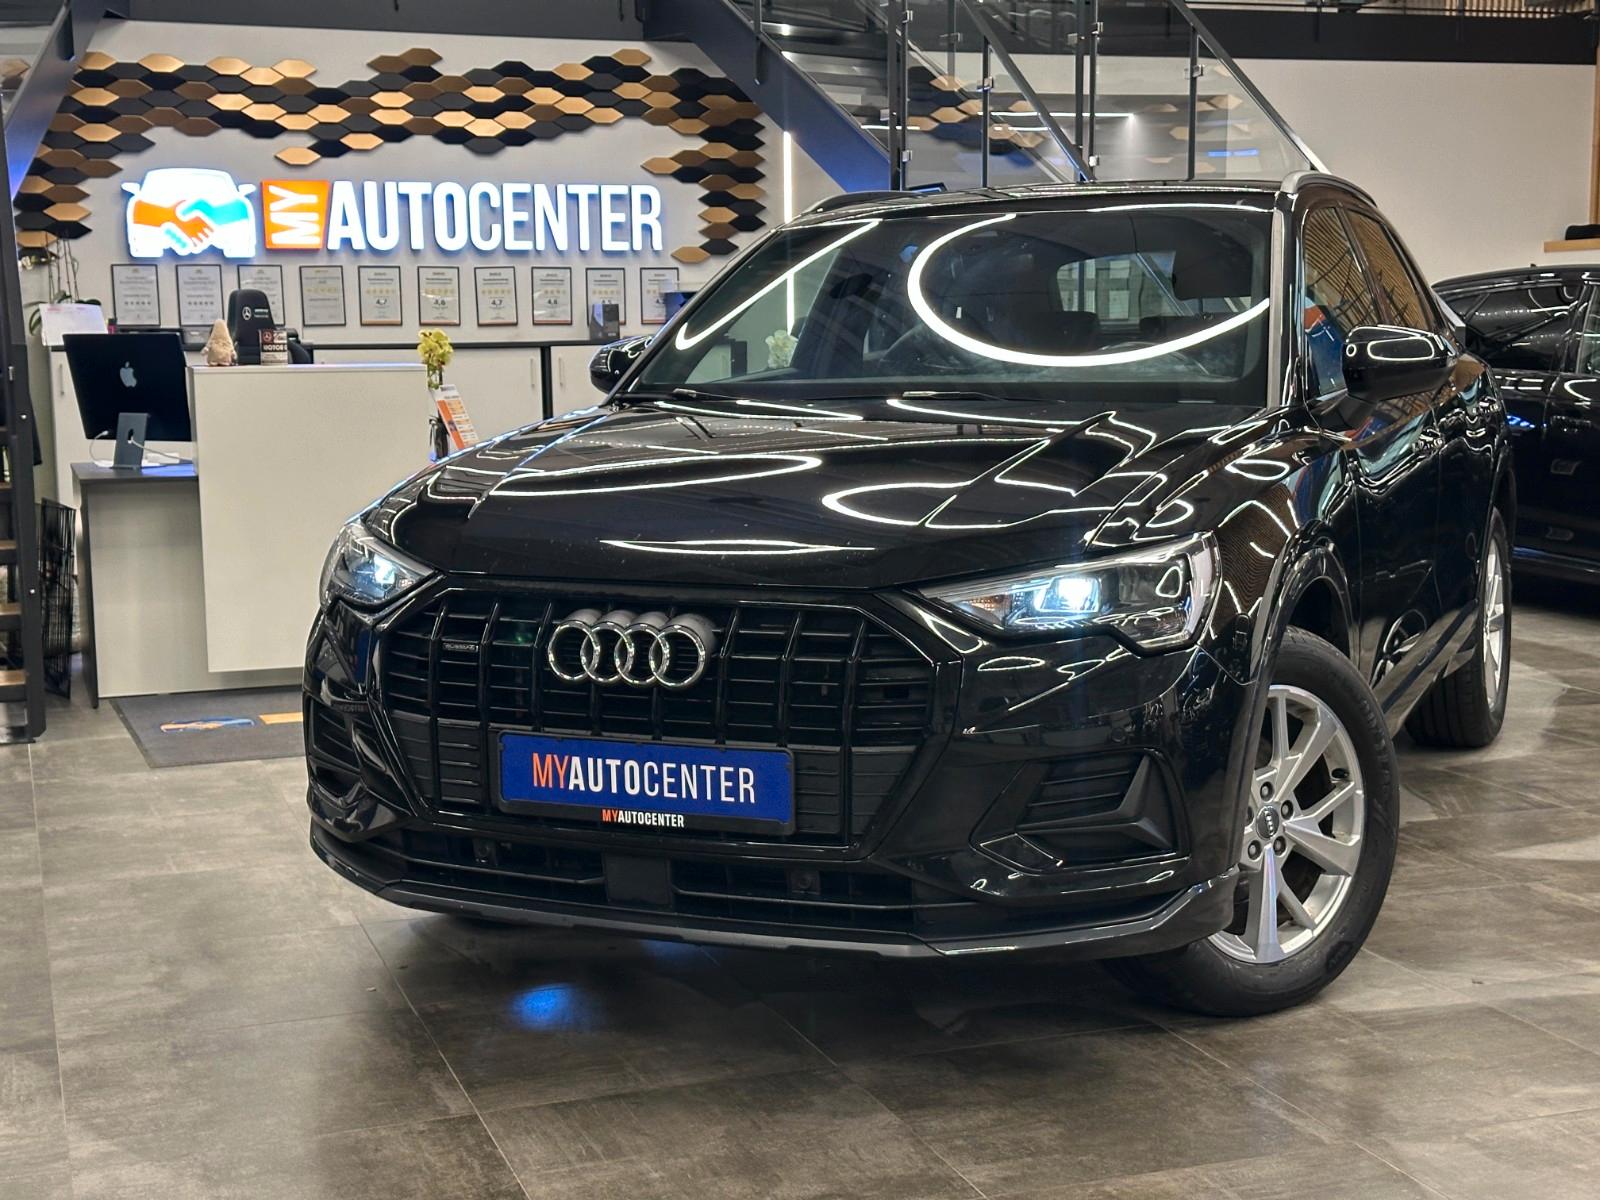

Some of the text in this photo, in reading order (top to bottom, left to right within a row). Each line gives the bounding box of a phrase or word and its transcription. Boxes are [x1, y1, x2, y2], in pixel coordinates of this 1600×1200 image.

[268, 179, 664, 252] MY AUTOCENTER
[532, 752, 756, 804] MYAUTOCENTER
[602, 808, 685, 828] MYAUTOCENTER
